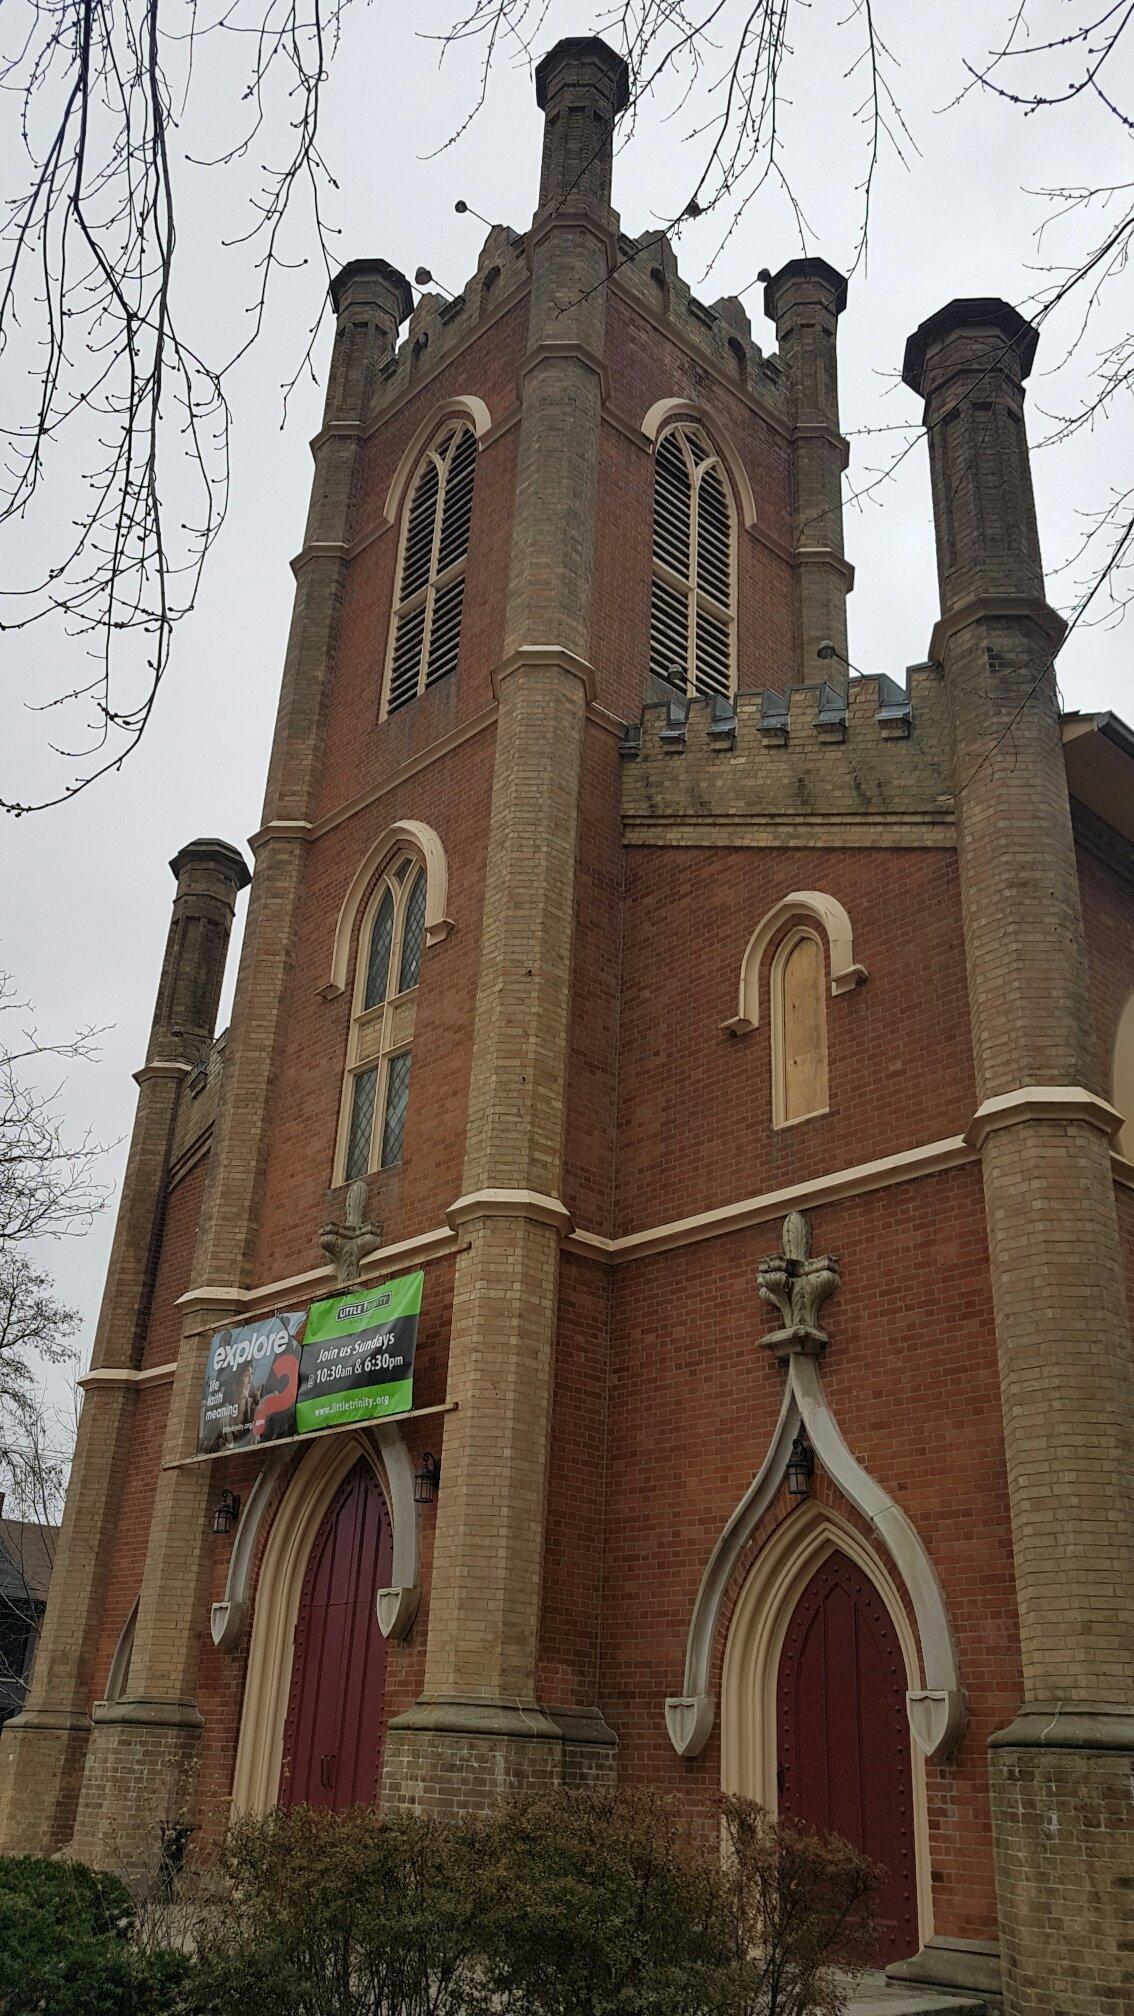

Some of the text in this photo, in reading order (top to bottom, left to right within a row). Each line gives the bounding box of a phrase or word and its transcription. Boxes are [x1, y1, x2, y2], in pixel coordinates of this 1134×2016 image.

[339, 1305, 362, 1318] LITTLE
[213, 1329, 289, 1371] explore
[317, 1332, 395, 1363] Join us Sundays
[316, 1364, 352, 1383] 10:30am
[354, 1358, 362, 1374] &
[364, 1353, 403, 1370] 6:30pm
[208, 1379, 220, 1392] life
[206, 1392, 223, 1407] faith
[314, 1395, 389, 1416] www.littletrinity.org
[205, 1403, 239, 1421] meaning
